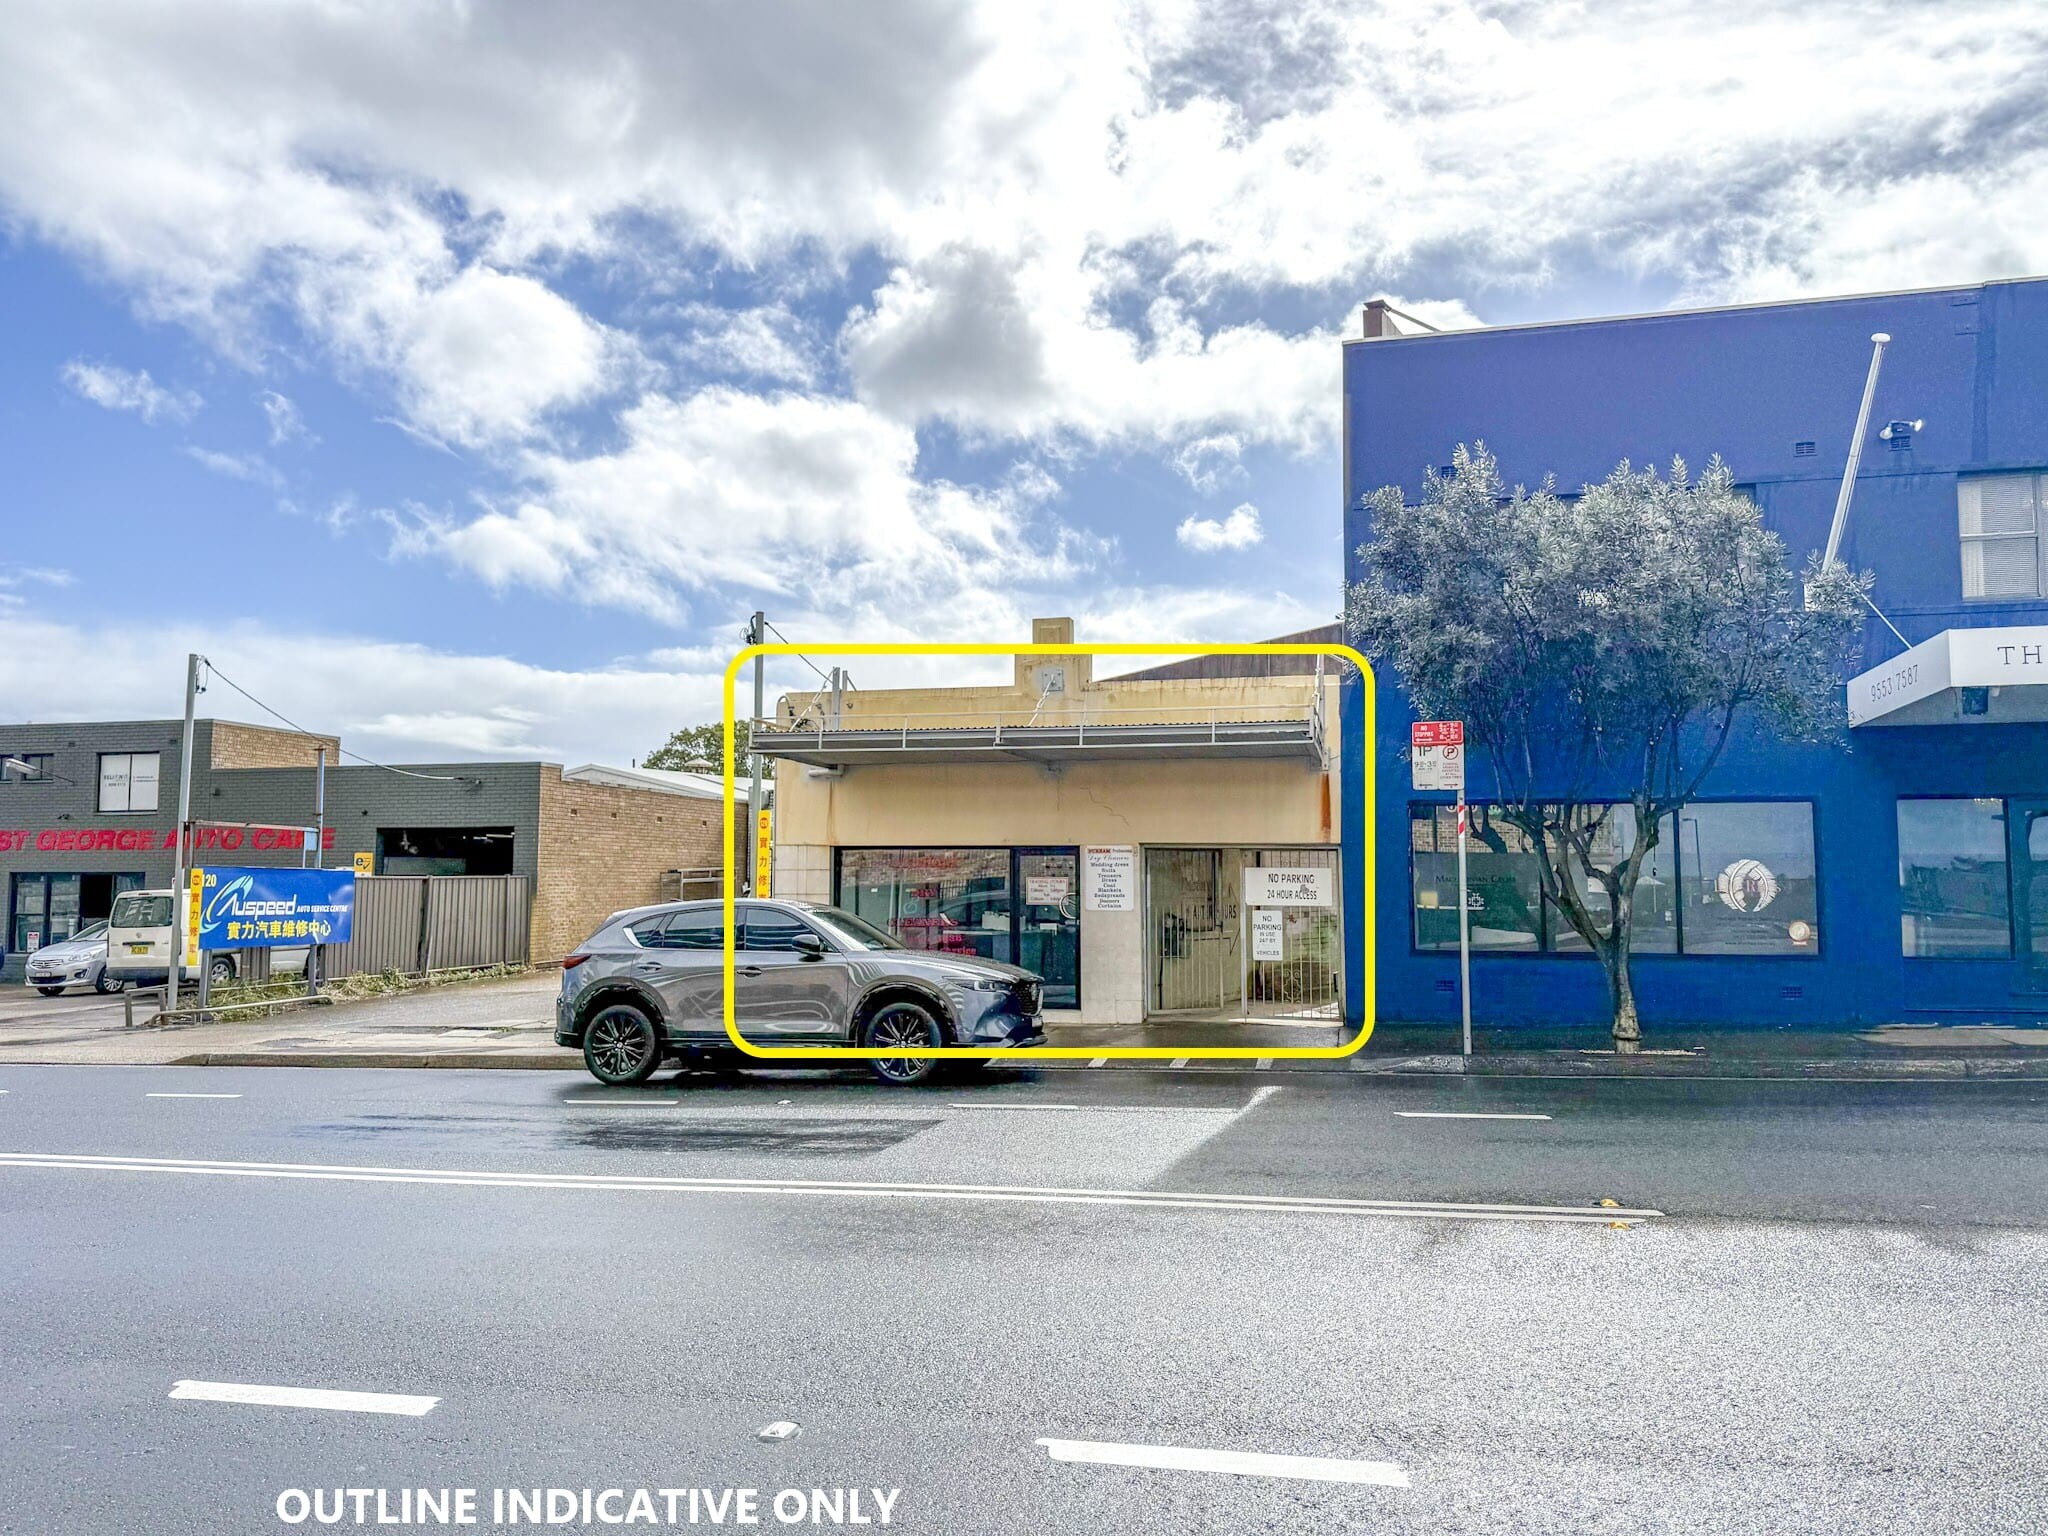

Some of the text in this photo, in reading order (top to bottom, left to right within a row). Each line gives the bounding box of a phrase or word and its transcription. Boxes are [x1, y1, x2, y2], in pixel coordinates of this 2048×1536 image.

[1997, 645, 2043, 665] TH
[1871, 664, 1918, 702] 9553 7587
[0, 829, 31, 850] ST
[36, 829, 156, 851] GEORGE
[1268, 873, 1315, 884] NO PARKING
[1267, 890, 1318, 900] 24 HOUR ACCESS
[227, 919, 331, 940] 實力汽車維修中心
